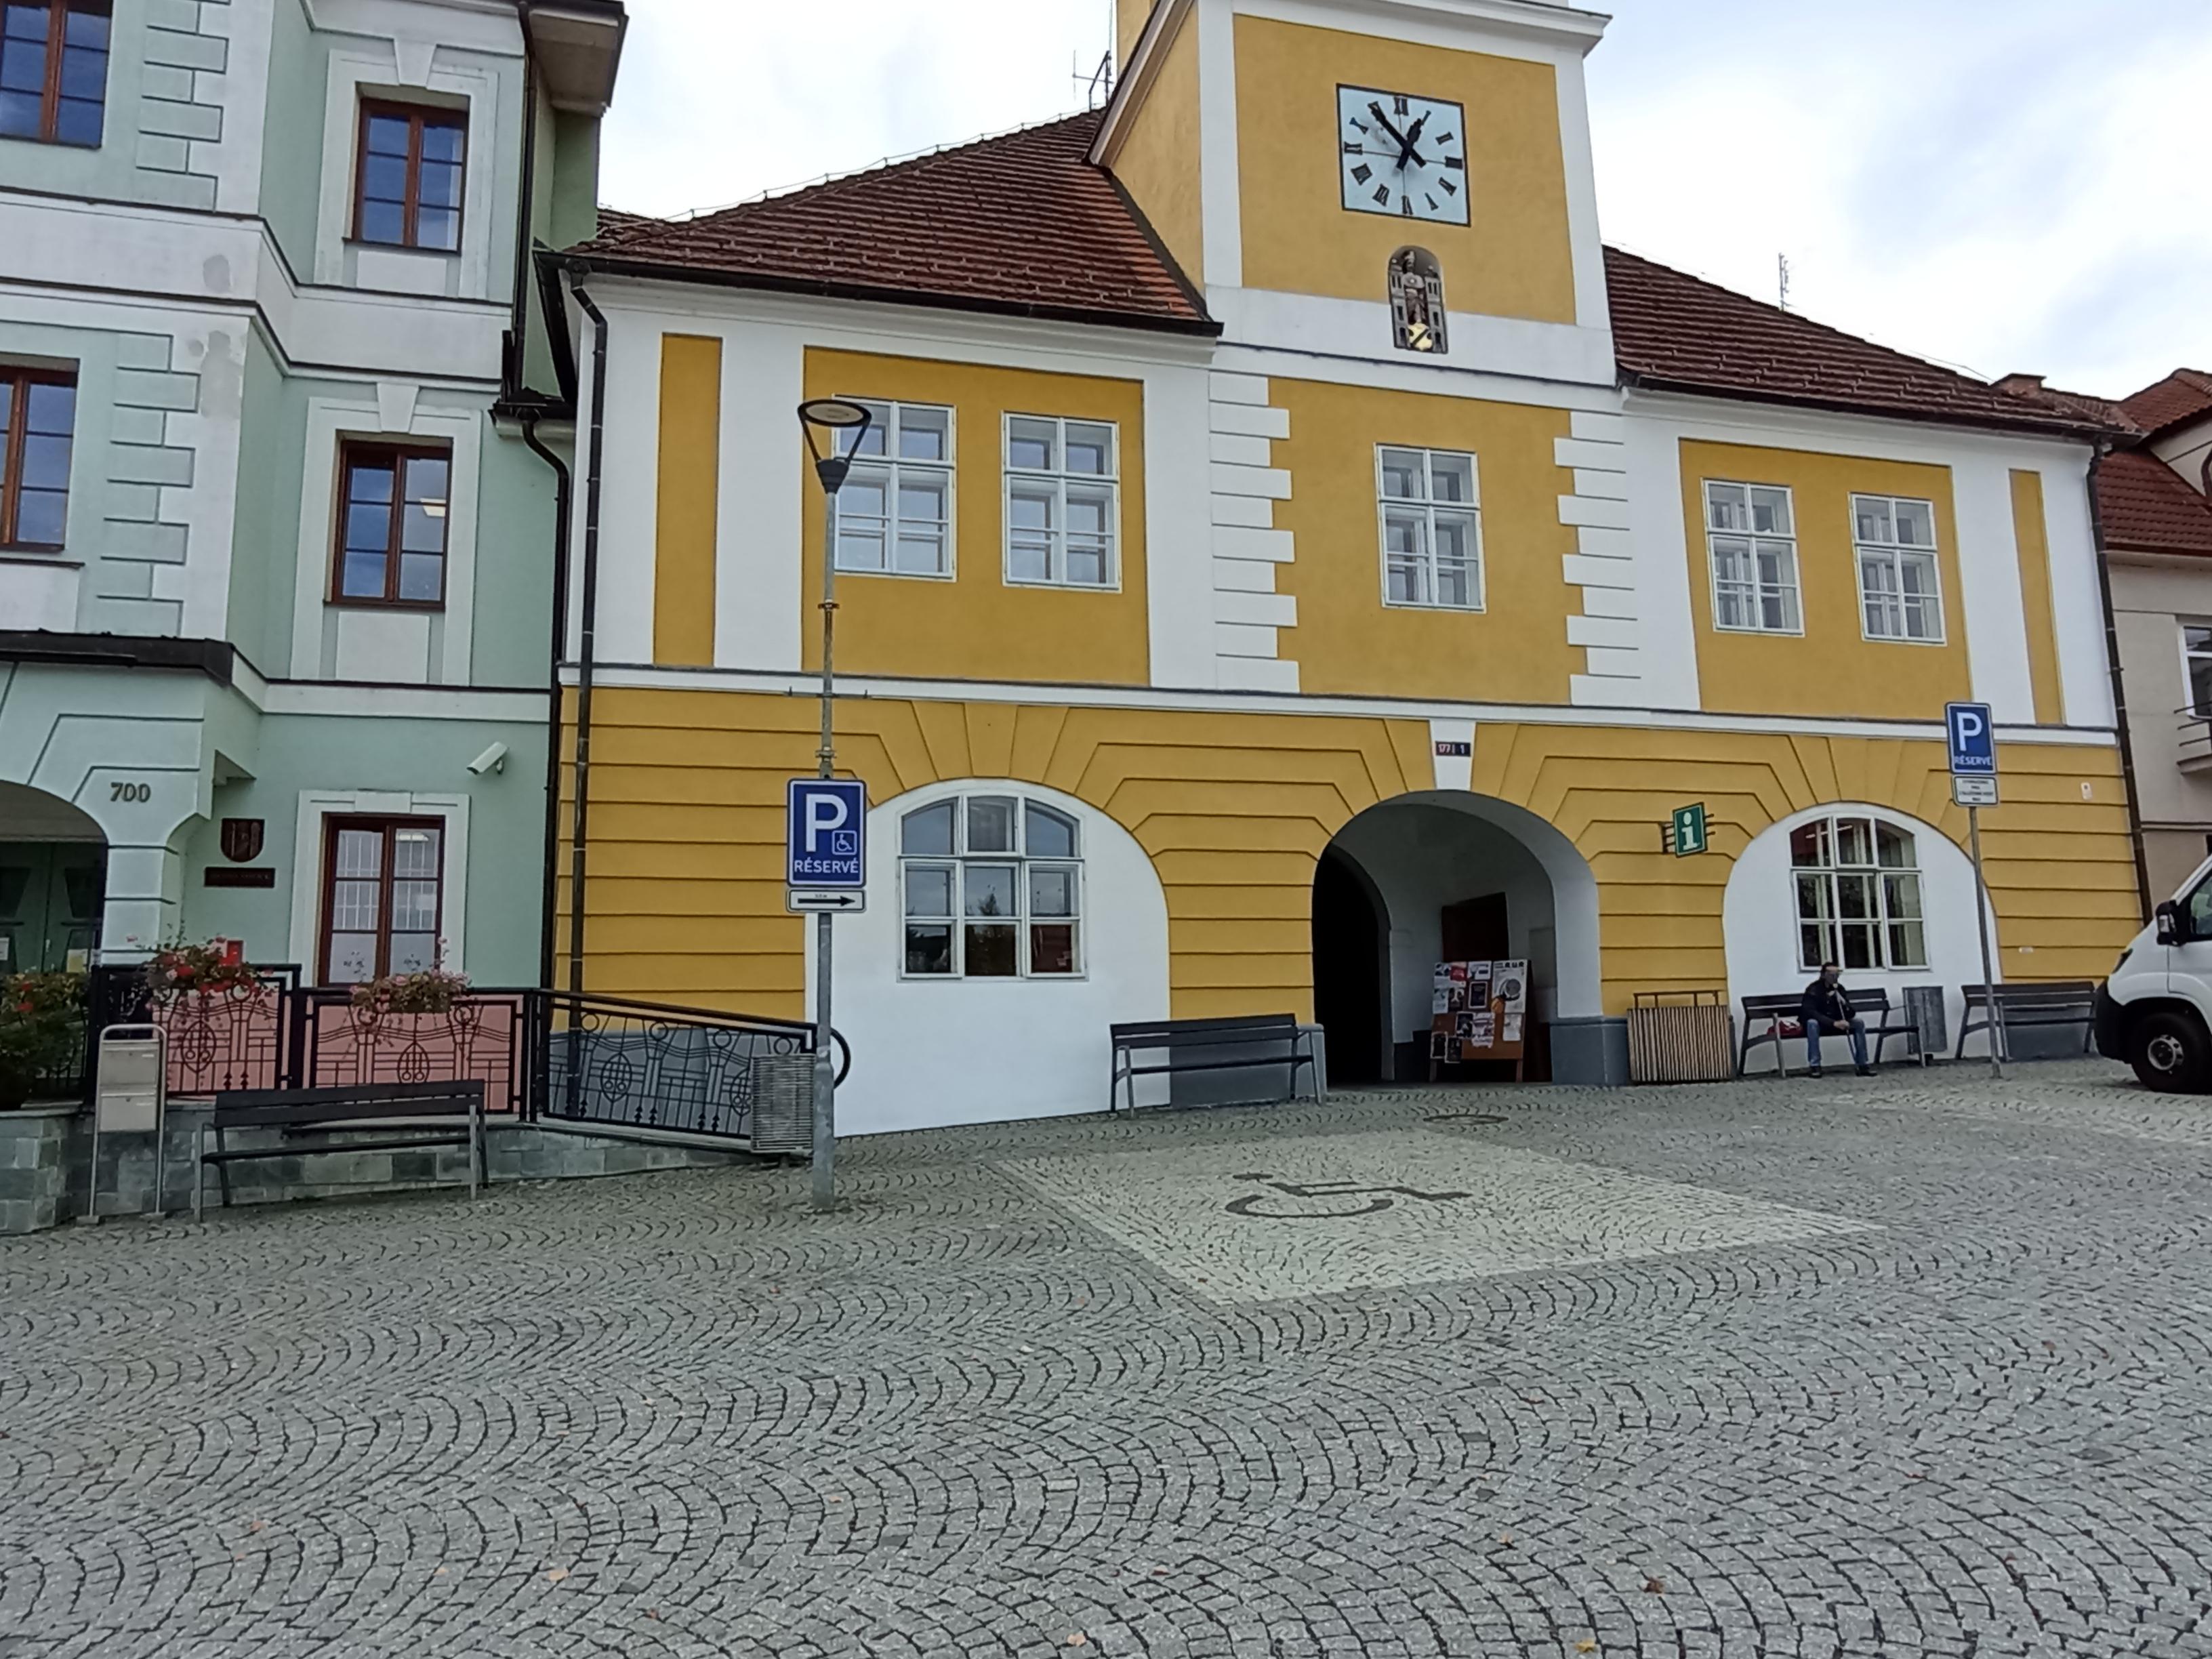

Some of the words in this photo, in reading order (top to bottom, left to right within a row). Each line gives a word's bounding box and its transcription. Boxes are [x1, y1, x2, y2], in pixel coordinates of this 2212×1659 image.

[1956, 712, 1982, 752] P
[110, 781, 151, 803] 700
[806, 793, 848, 853] P
[794, 857, 859, 874] RÉSERVÉ
